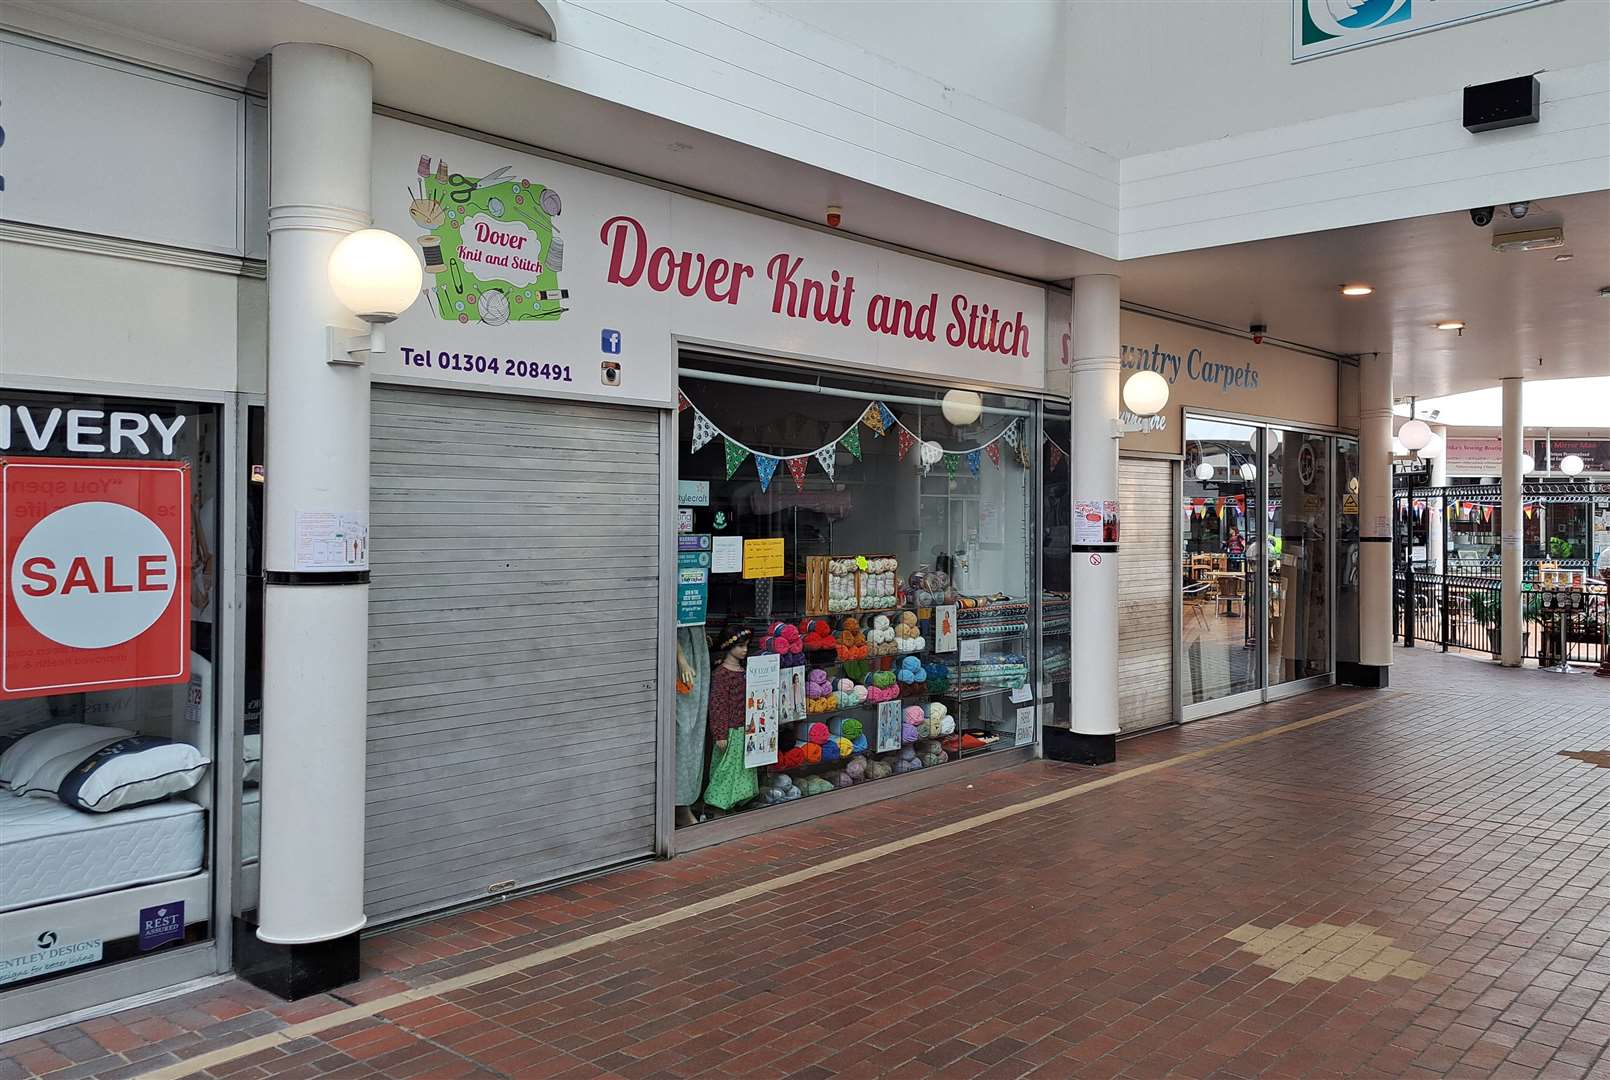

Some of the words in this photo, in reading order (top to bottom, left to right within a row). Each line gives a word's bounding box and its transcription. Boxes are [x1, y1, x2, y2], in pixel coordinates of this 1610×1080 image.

[475, 222, 528, 250] Dover
[457, 245, 482, 263] Knit
[485, 253, 508, 267] and
[511, 256, 543, 274] Stitch
[600, 215, 754, 305] Dover
[766, 252, 856, 326] Knit
[866, 293, 938, 342] and
[946, 294, 1030, 358] Stitch
[400, 347, 432, 367] Tel
[438, 351, 499, 374] 01304
[505, 359, 573, 382] 208491
[1187, 348, 1259, 391] Carpets
[0, 404, 186, 456] IVERY
[21, 554, 169, 597] SALE
[144, 924, 179, 937] ASSURED
[145, 914, 179, 930] REST
[50, 938, 101, 958] DESIGNS
